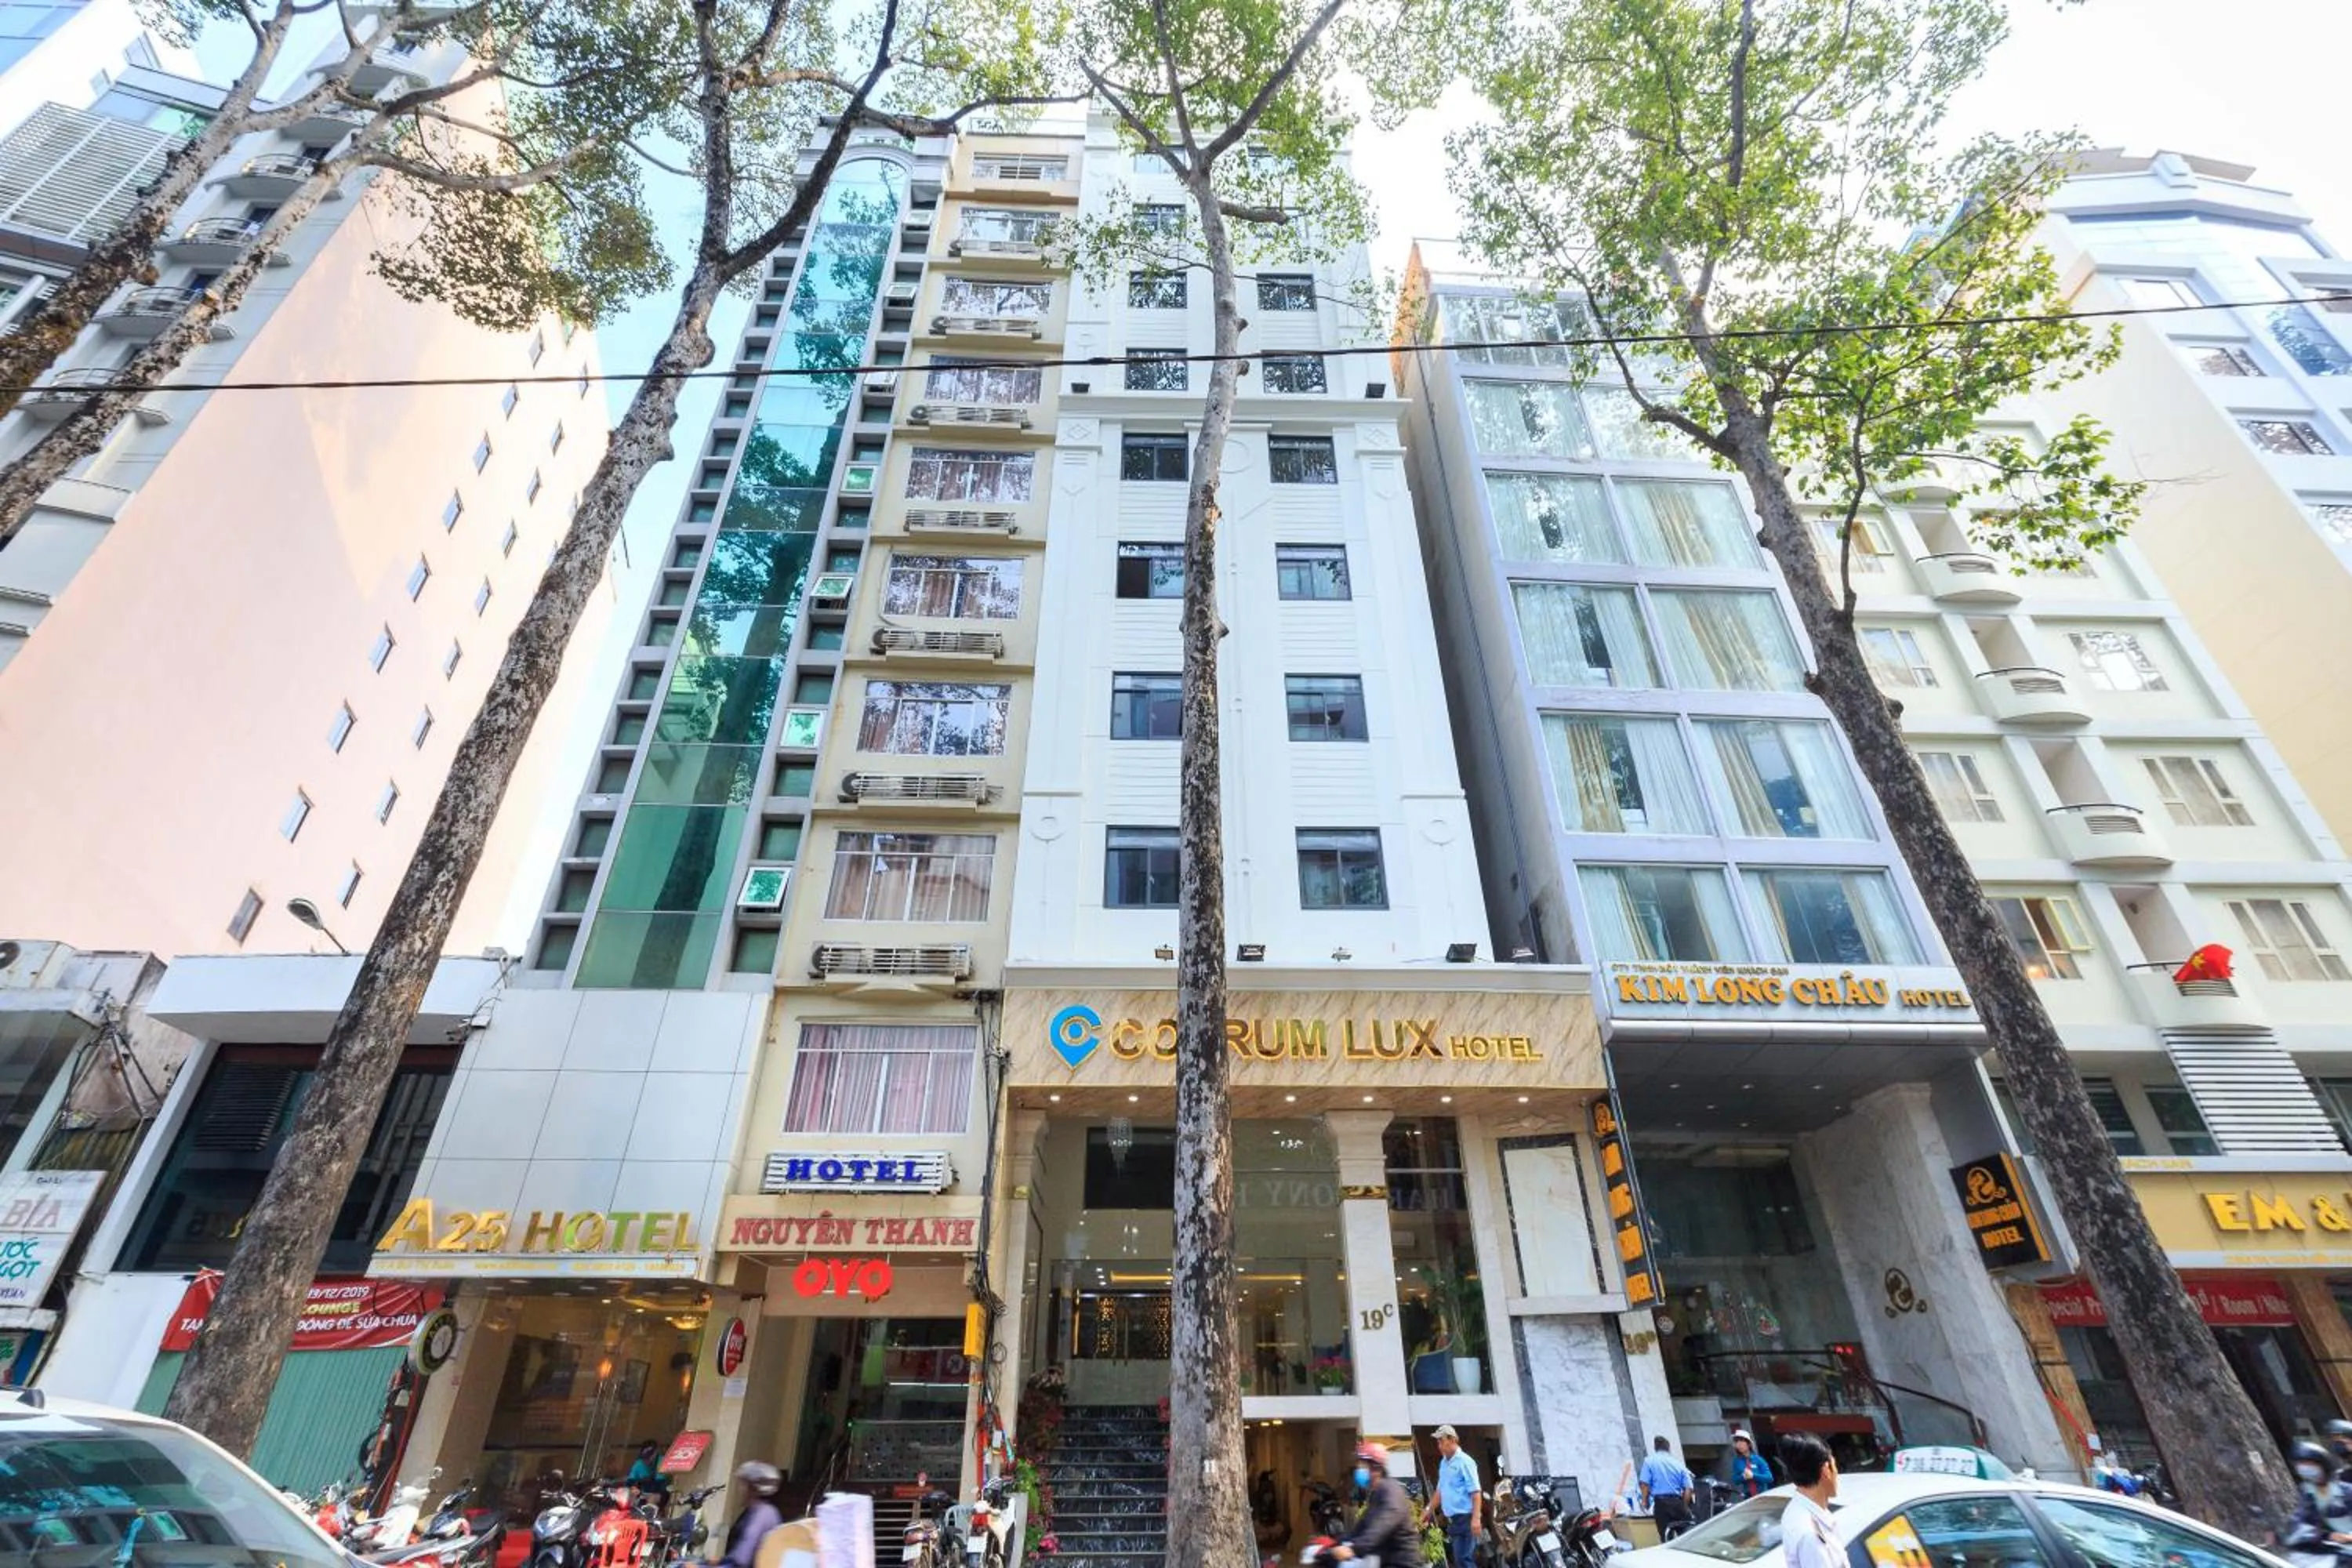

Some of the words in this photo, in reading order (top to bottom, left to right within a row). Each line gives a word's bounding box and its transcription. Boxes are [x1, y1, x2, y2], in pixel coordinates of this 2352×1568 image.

[1616, 975, 1689, 1004] KIM
[1690, 976, 1787, 1005] LONG
[1791, 970, 1889, 1005] CHÂU
[1898, 989, 1972, 1007] HOTEL
[1110, 1017, 1328, 1062] CORUM
[1343, 1018, 1444, 1061] LUX
[1449, 1035, 1544, 1063] HOTEL
[786, 1158, 924, 1183] HOTEL
[377, 1196, 508, 1251] A25
[521, 1210, 701, 1253] HOTEL
[2205, 1189, 2307, 1232] EM
[2312, 1193, 2352, 1232] &
[865, 1216, 975, 1247] THANH
[792, 1257, 894, 1299] OYO
[2046, 1296, 2085, 1319] pecial
